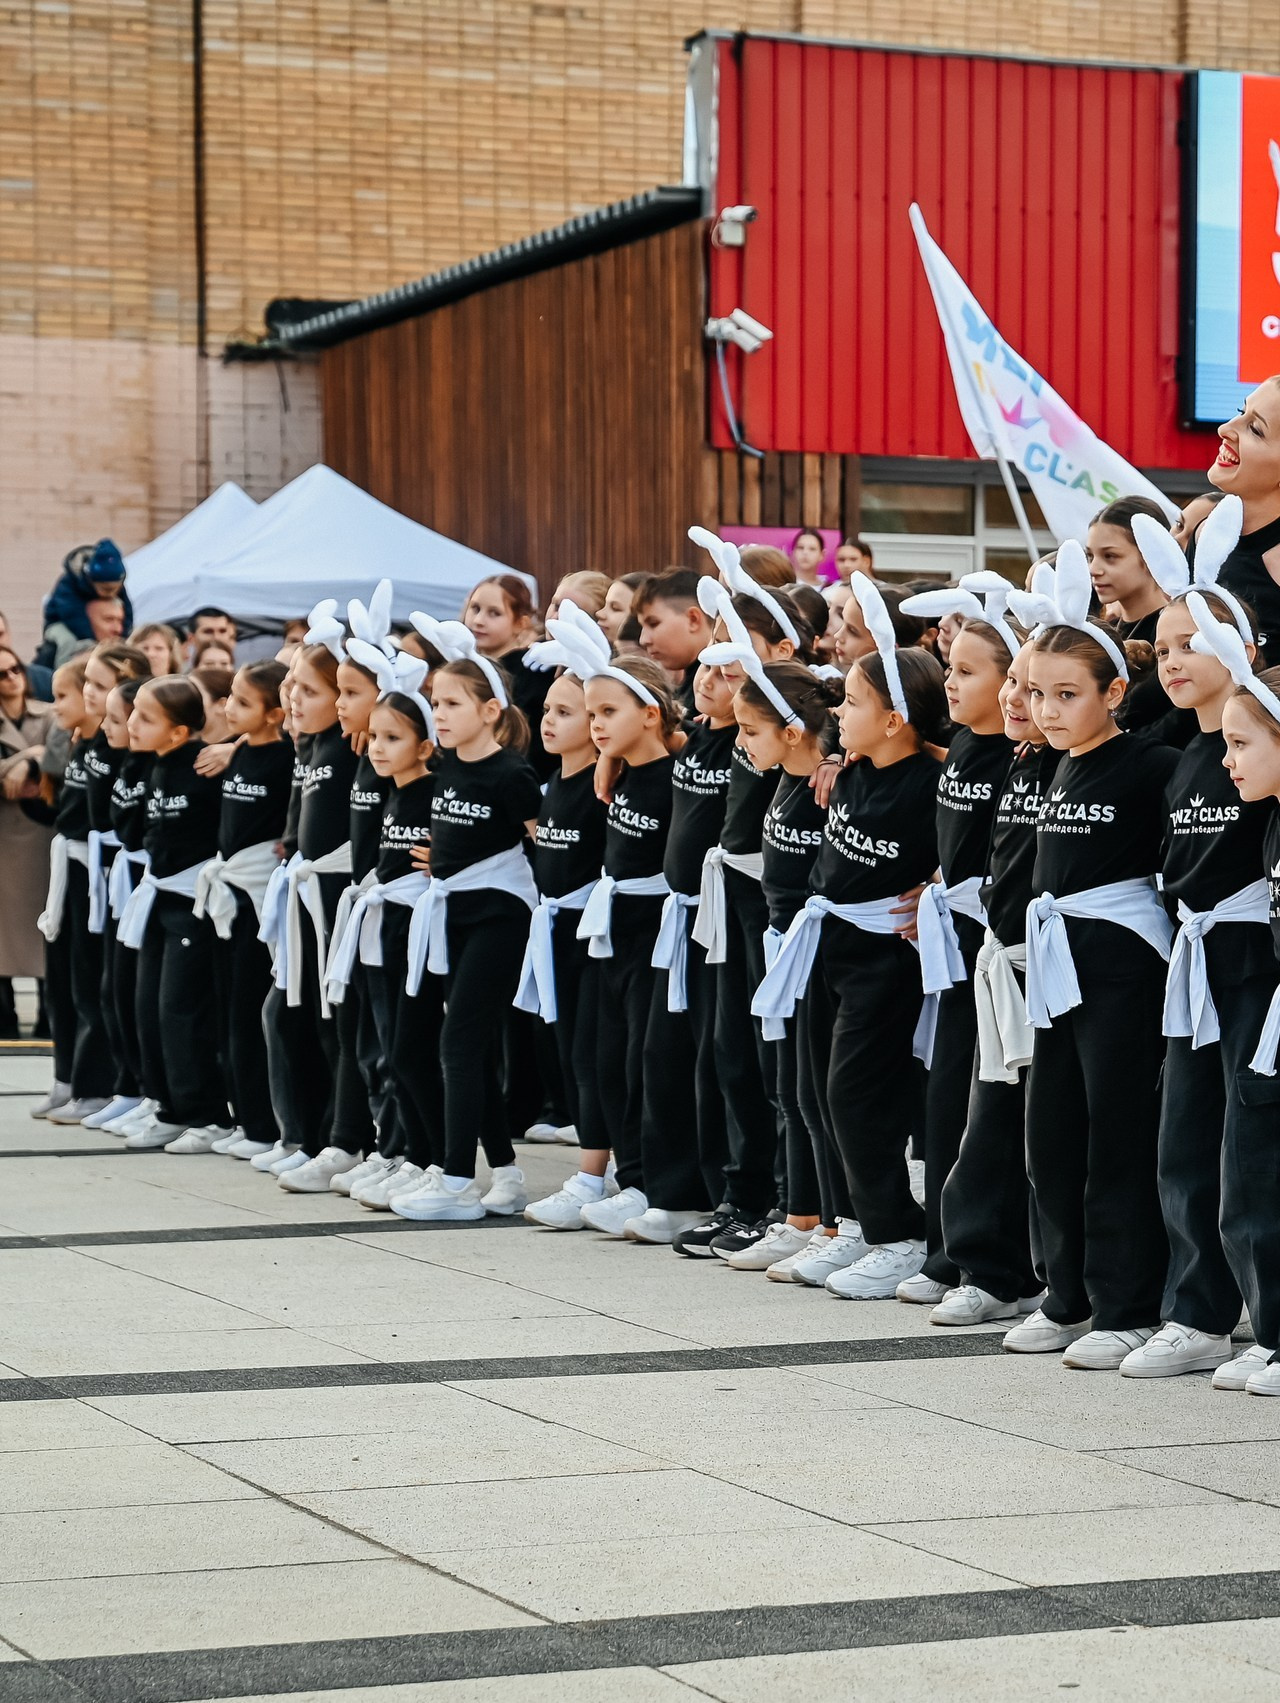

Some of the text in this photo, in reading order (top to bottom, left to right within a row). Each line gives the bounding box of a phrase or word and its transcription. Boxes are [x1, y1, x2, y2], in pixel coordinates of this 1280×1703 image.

[1024, 442, 1119, 504] CLAS
[949, 779, 992, 801] CLASS
[448, 799, 492, 820] CLASS
[619, 806, 660, 831] CLASS
[1056, 803, 1117, 824] CLASS
[1199, 805, 1241, 823] CLASS
[388, 825, 431, 841] CLASS
[550, 827, 580, 843] CLASS
[774, 822, 822, 846] CLASS
[1043, 823, 1092, 836] Лебедевой
[844, 824, 901, 860] CLASS
